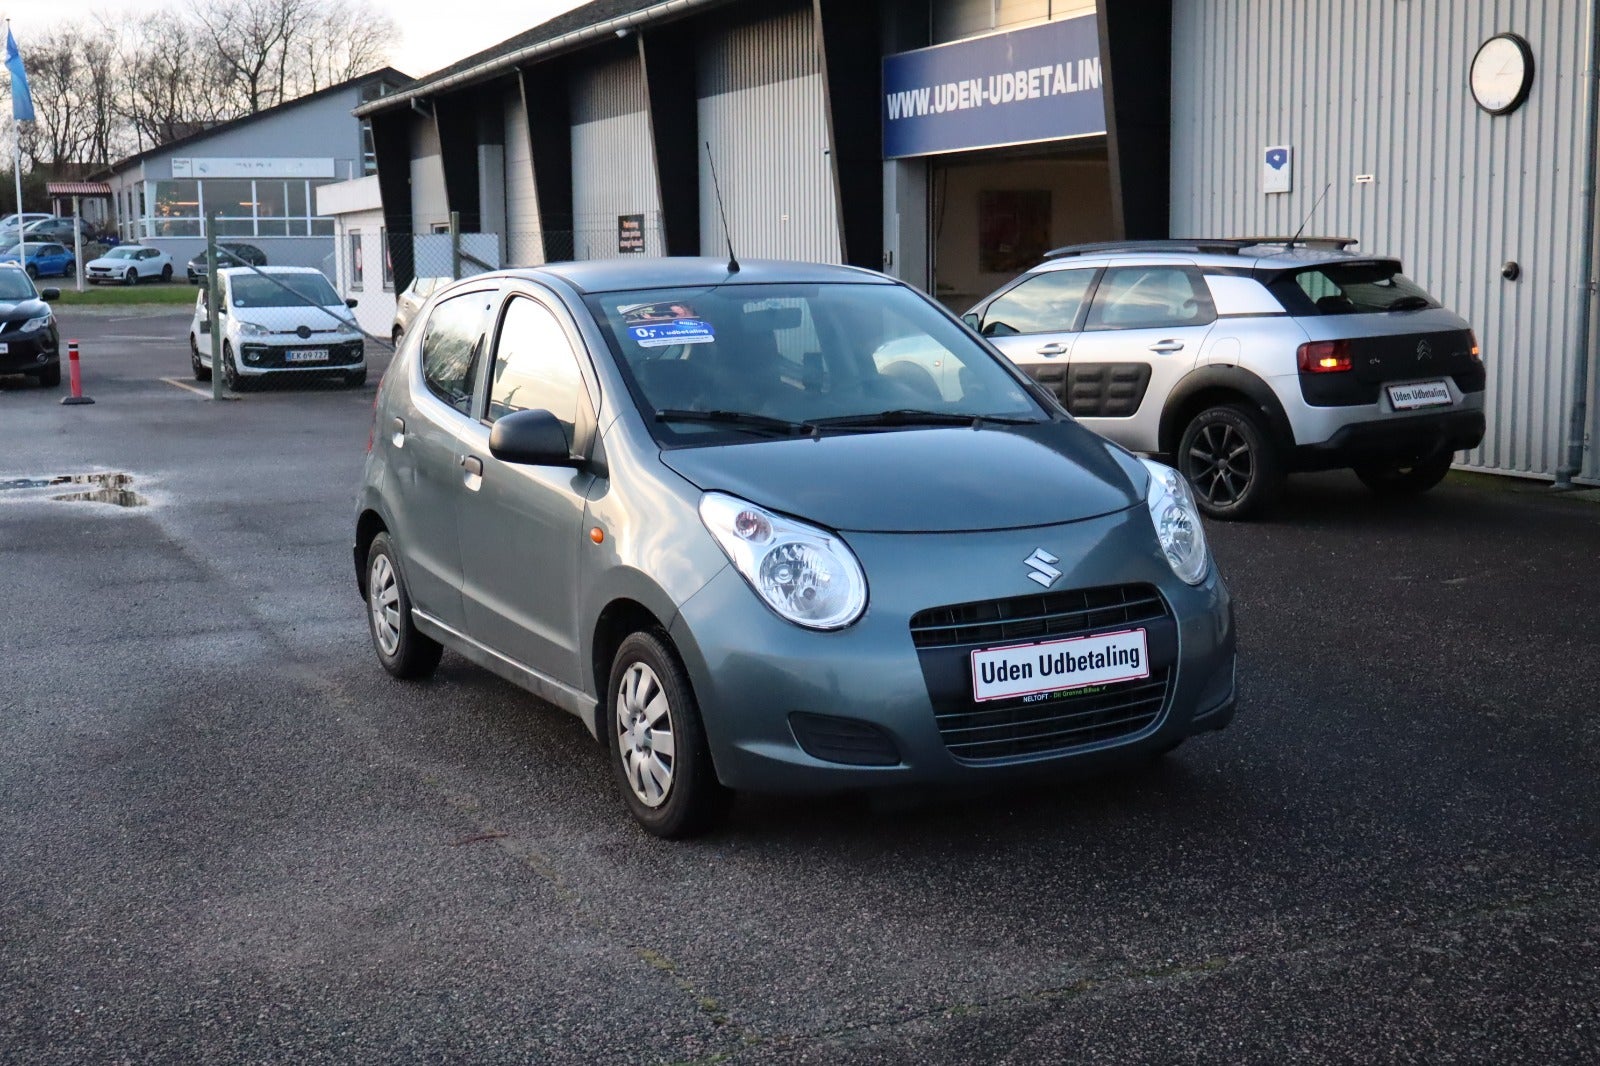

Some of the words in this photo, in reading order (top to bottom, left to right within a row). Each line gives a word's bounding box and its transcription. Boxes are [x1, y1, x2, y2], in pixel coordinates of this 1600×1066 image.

[886, 56, 1103, 121] WWW.UDEN-UDBETALIN
[1393, 391, 1411, 402] Uden
[1412, 387, 1448, 400] Udbetaling
[981, 660, 1033, 684] Uden
[1039, 645, 1140, 677] Udbetaling
[1023, 693, 1049, 703] NELTOFT
